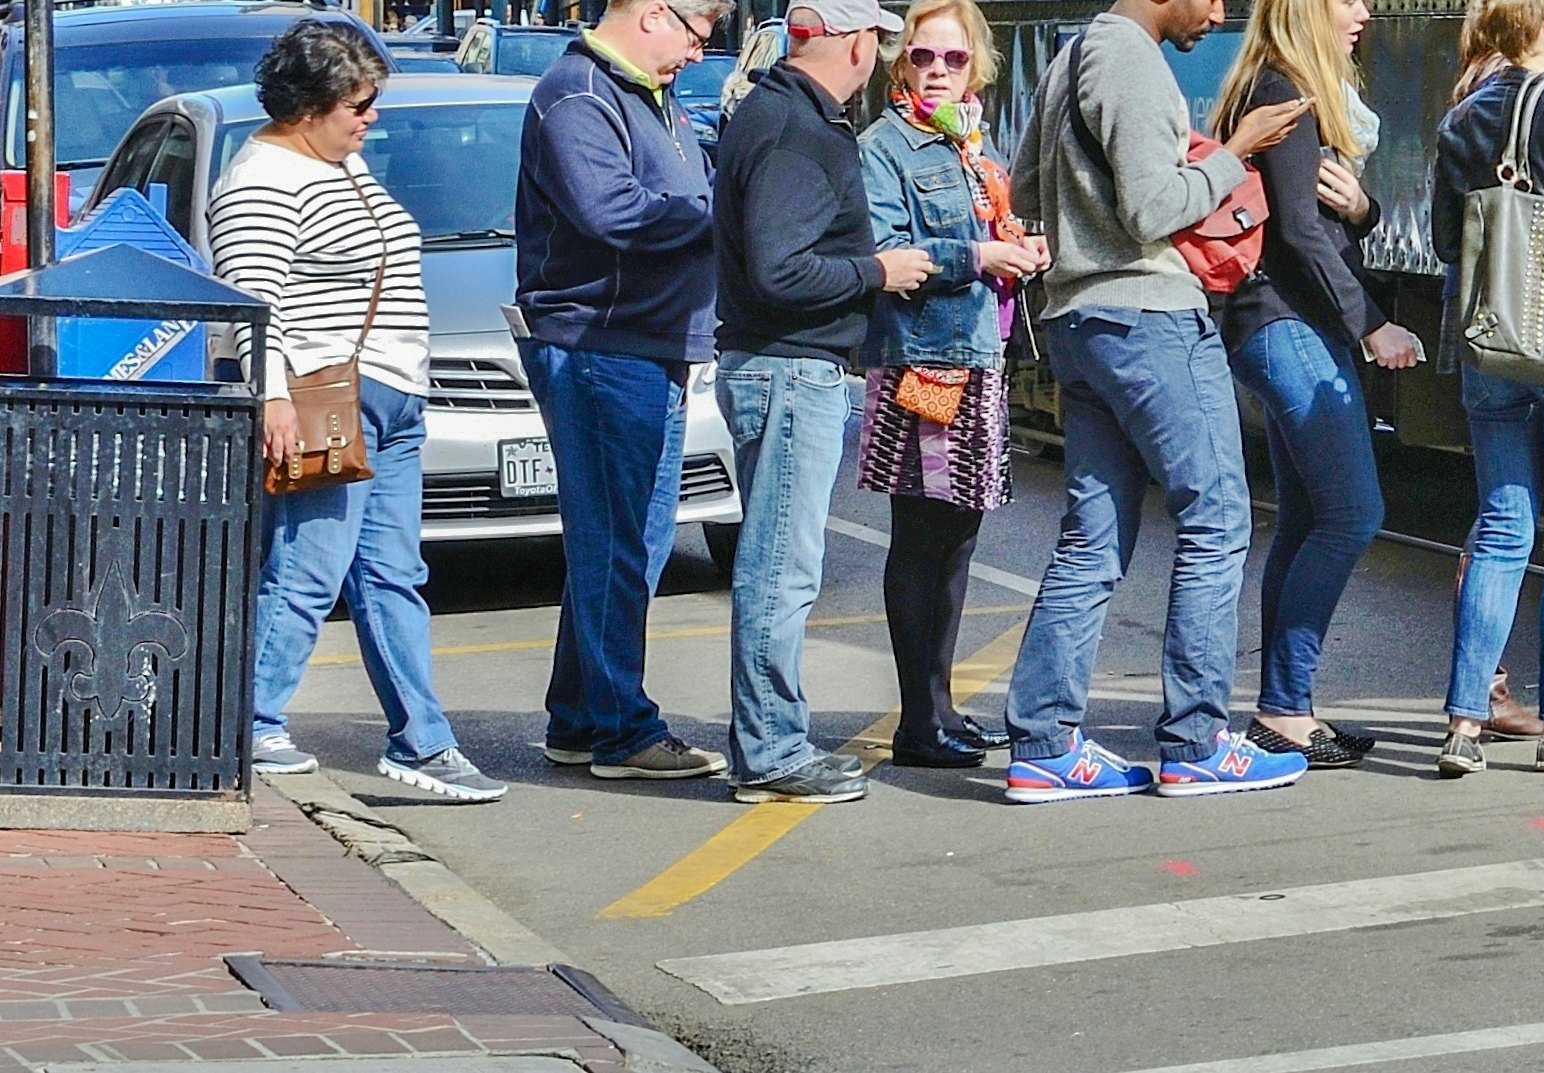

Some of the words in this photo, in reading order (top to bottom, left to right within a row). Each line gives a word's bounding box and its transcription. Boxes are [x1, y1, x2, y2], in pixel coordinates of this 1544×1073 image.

[532, 441, 550, 453] TE
[506, 458, 542, 485] DTF
[1069, 756, 1103, 786] N
[1218, 750, 1252, 777] N
